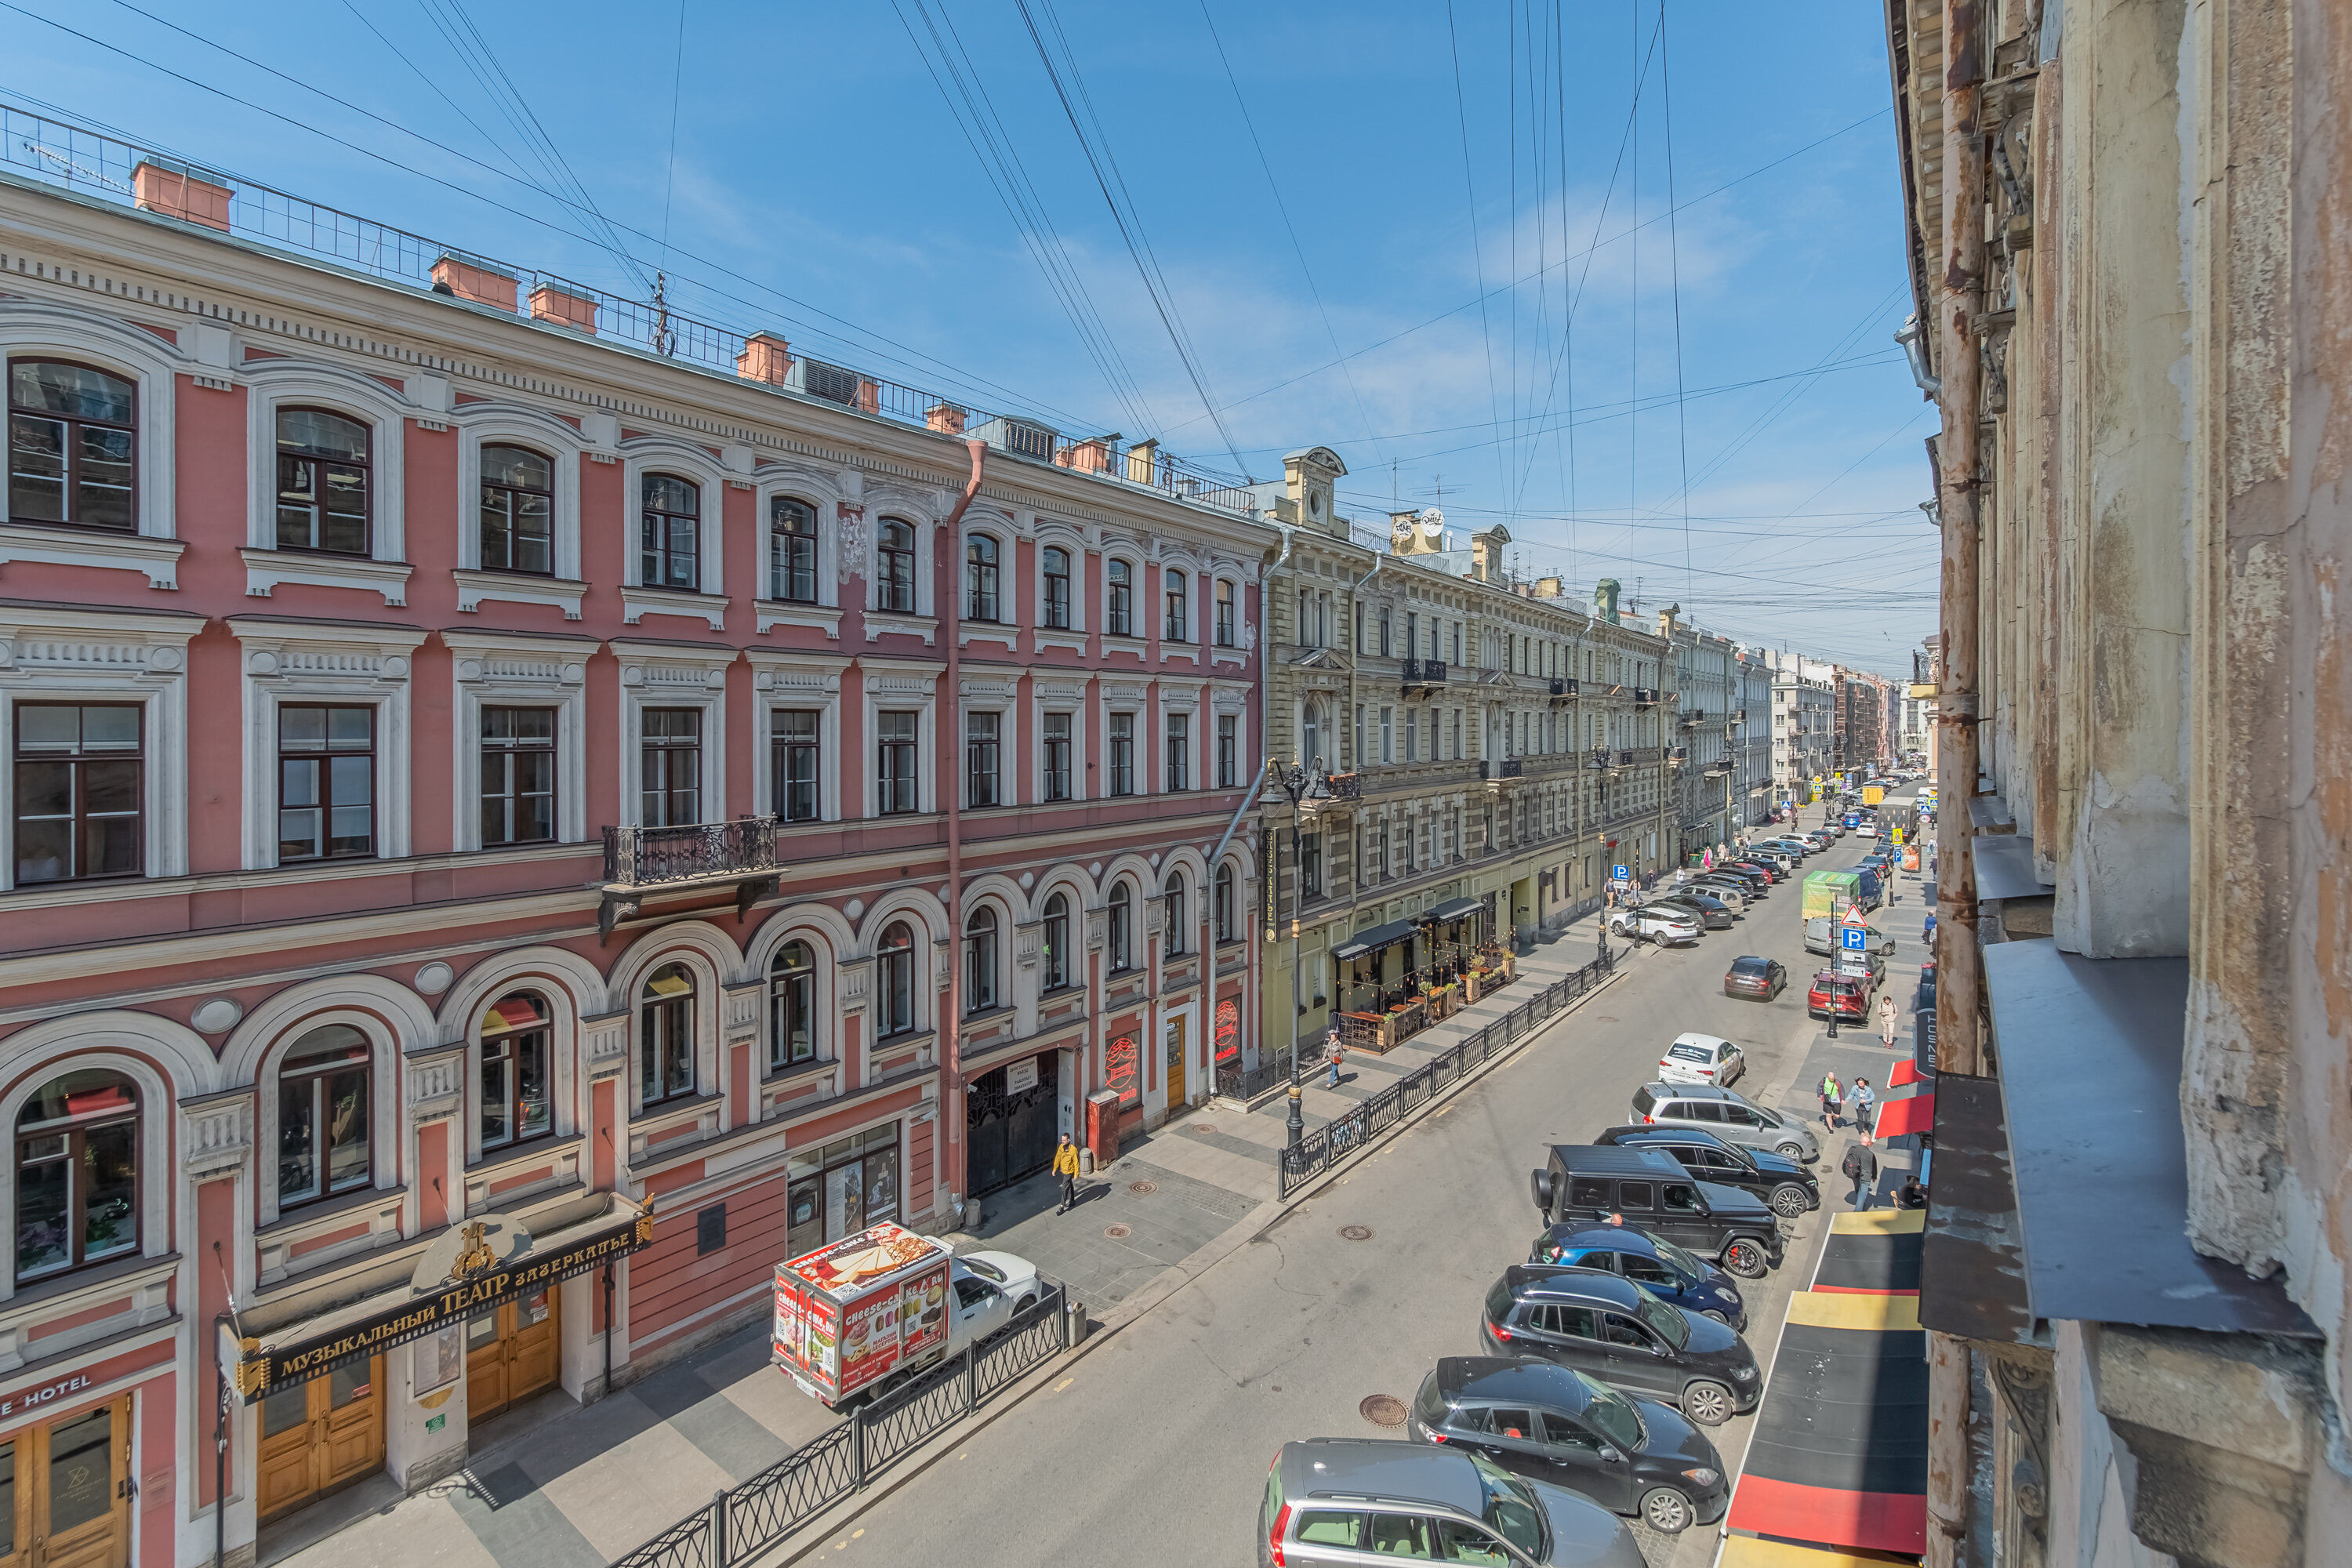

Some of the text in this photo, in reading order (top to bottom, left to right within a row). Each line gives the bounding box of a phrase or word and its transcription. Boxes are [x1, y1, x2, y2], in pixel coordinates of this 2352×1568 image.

[1895, 851, 1901, 861] P
[1617, 866, 1627, 878] P
[1848, 931, 1862, 947] P
[281, 1305, 437, 1377] МУЗЫКАЛЬНЫЙ
[440, 1273, 510, 1315] ТЕАТР
[514, 1232, 630, 1287] ЗАЗЕРКАЛЬЕ
[873, 1330, 897, 1346] МАГАЗИН
[24, 1374, 93, 1407] HOTEL
